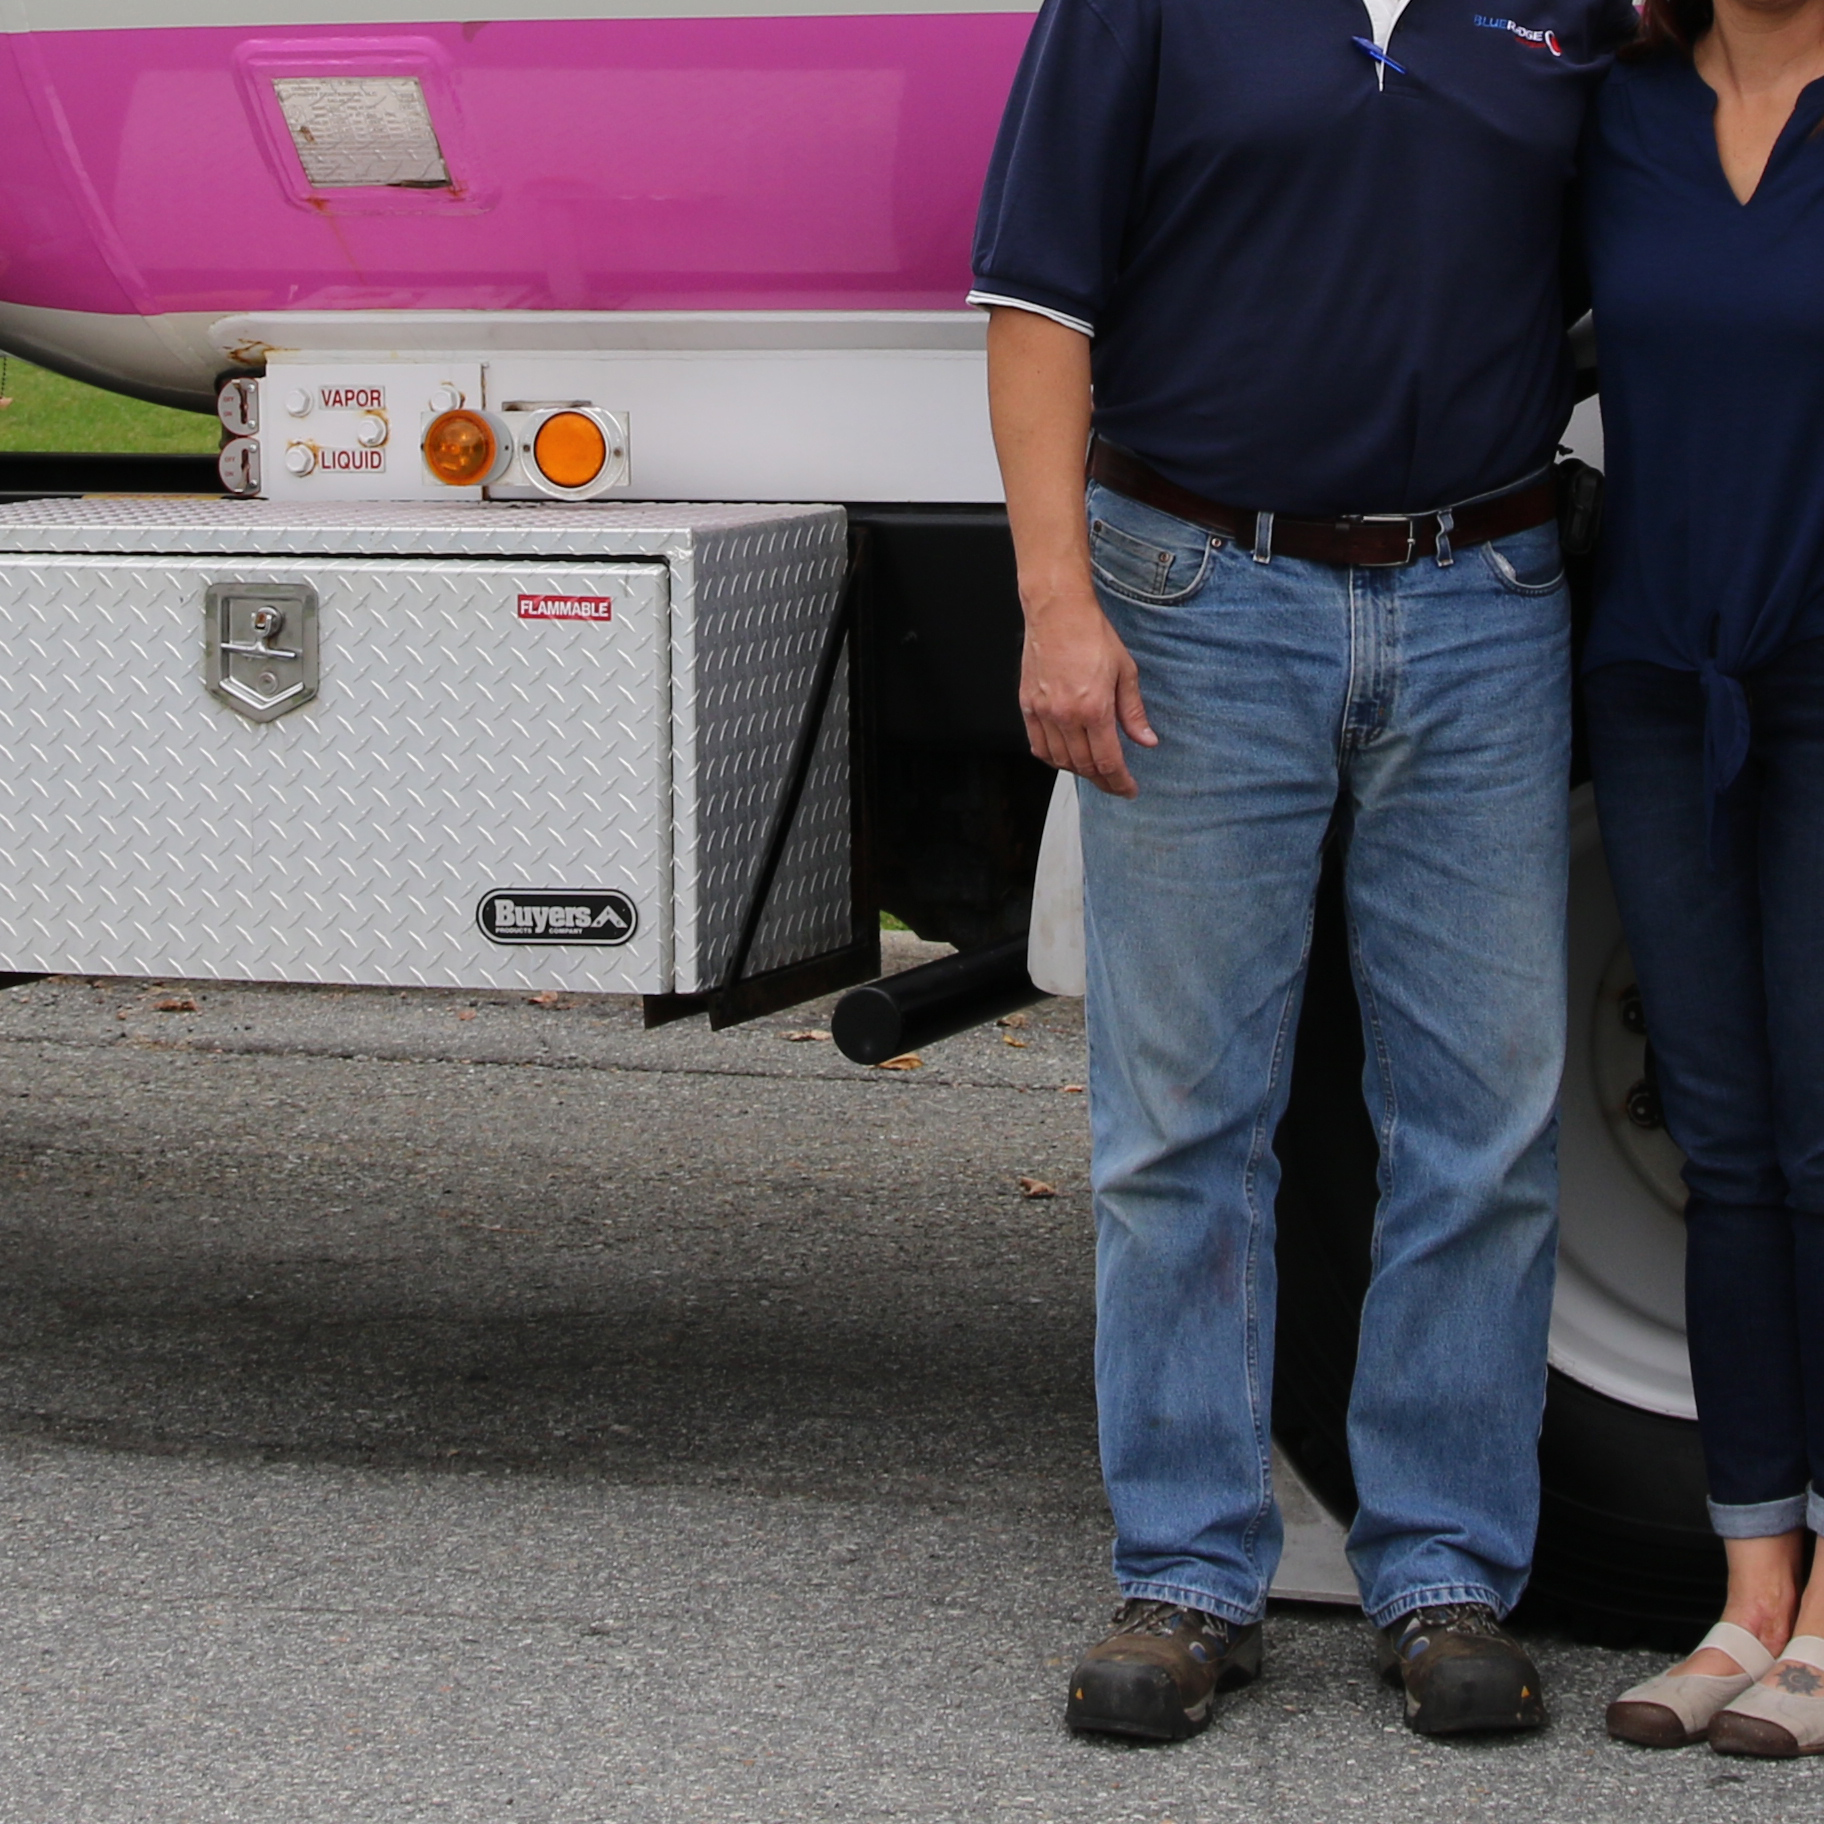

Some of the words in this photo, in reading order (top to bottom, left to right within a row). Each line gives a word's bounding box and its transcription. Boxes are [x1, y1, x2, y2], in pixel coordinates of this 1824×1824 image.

[321, 389, 382, 407] VAPOR
[321, 451, 382, 469] LIQUID
[520, 600, 609, 618] FLAMMABLE
[494, 899, 592, 934] Buyers
